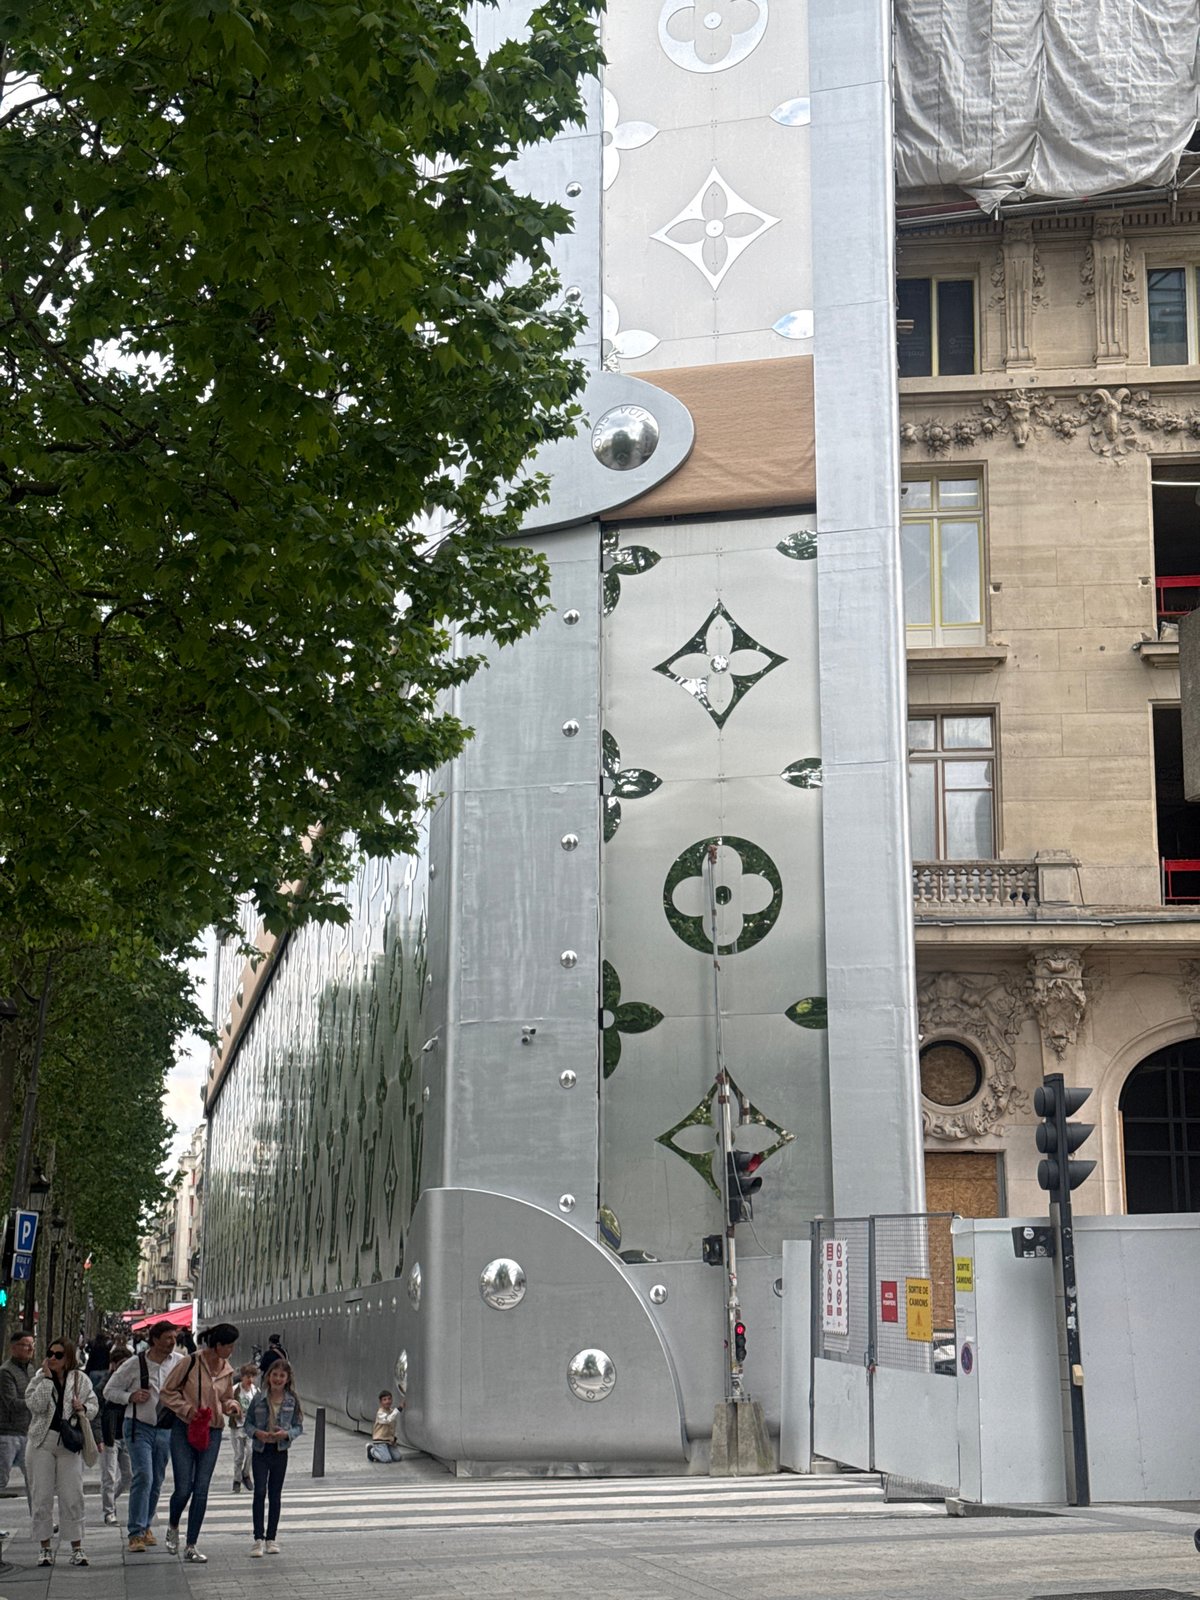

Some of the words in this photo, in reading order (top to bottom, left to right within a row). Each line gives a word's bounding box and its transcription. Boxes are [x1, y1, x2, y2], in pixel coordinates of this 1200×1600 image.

[22, 1220, 32, 1245] P
[957, 1263, 970, 1272] SORTIE
[956, 1276, 972, 1285] CAMIONS
[908, 1285, 922, 1295] SORTIE
[922, 1286, 929, 1295] DE
[909, 1298, 929, 1307] CAMIONS
